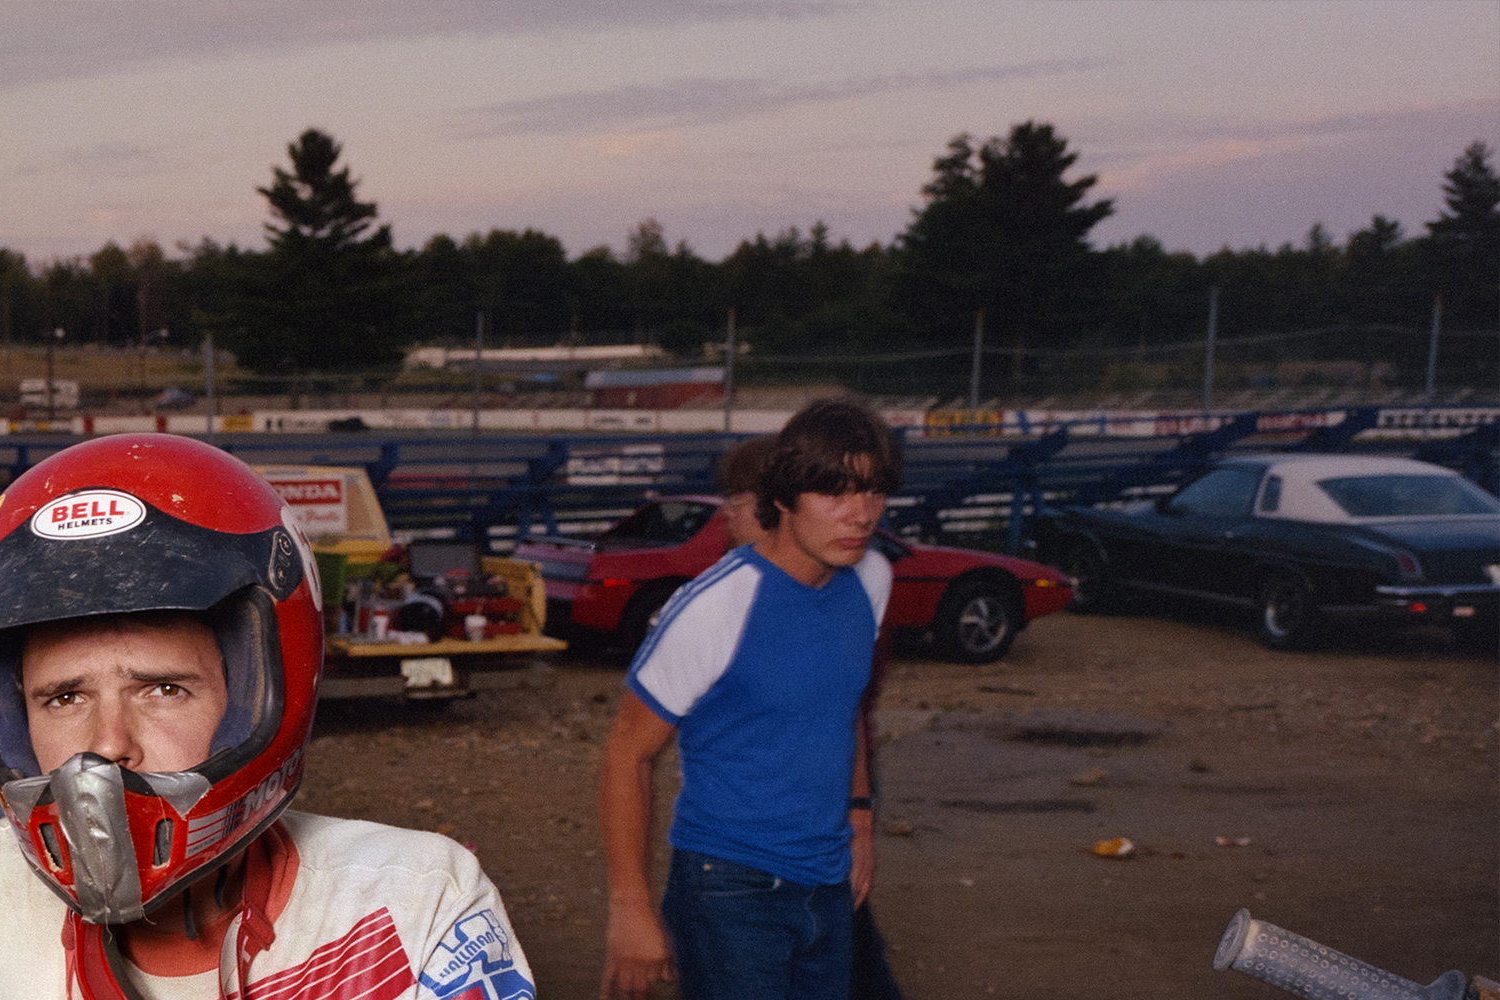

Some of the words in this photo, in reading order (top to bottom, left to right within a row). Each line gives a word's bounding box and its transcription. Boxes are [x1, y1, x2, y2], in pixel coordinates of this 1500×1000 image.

[51, 500, 125, 524] BELL
[57, 517, 113, 531] HELMETS
[242, 746, 303, 822] MOTO
